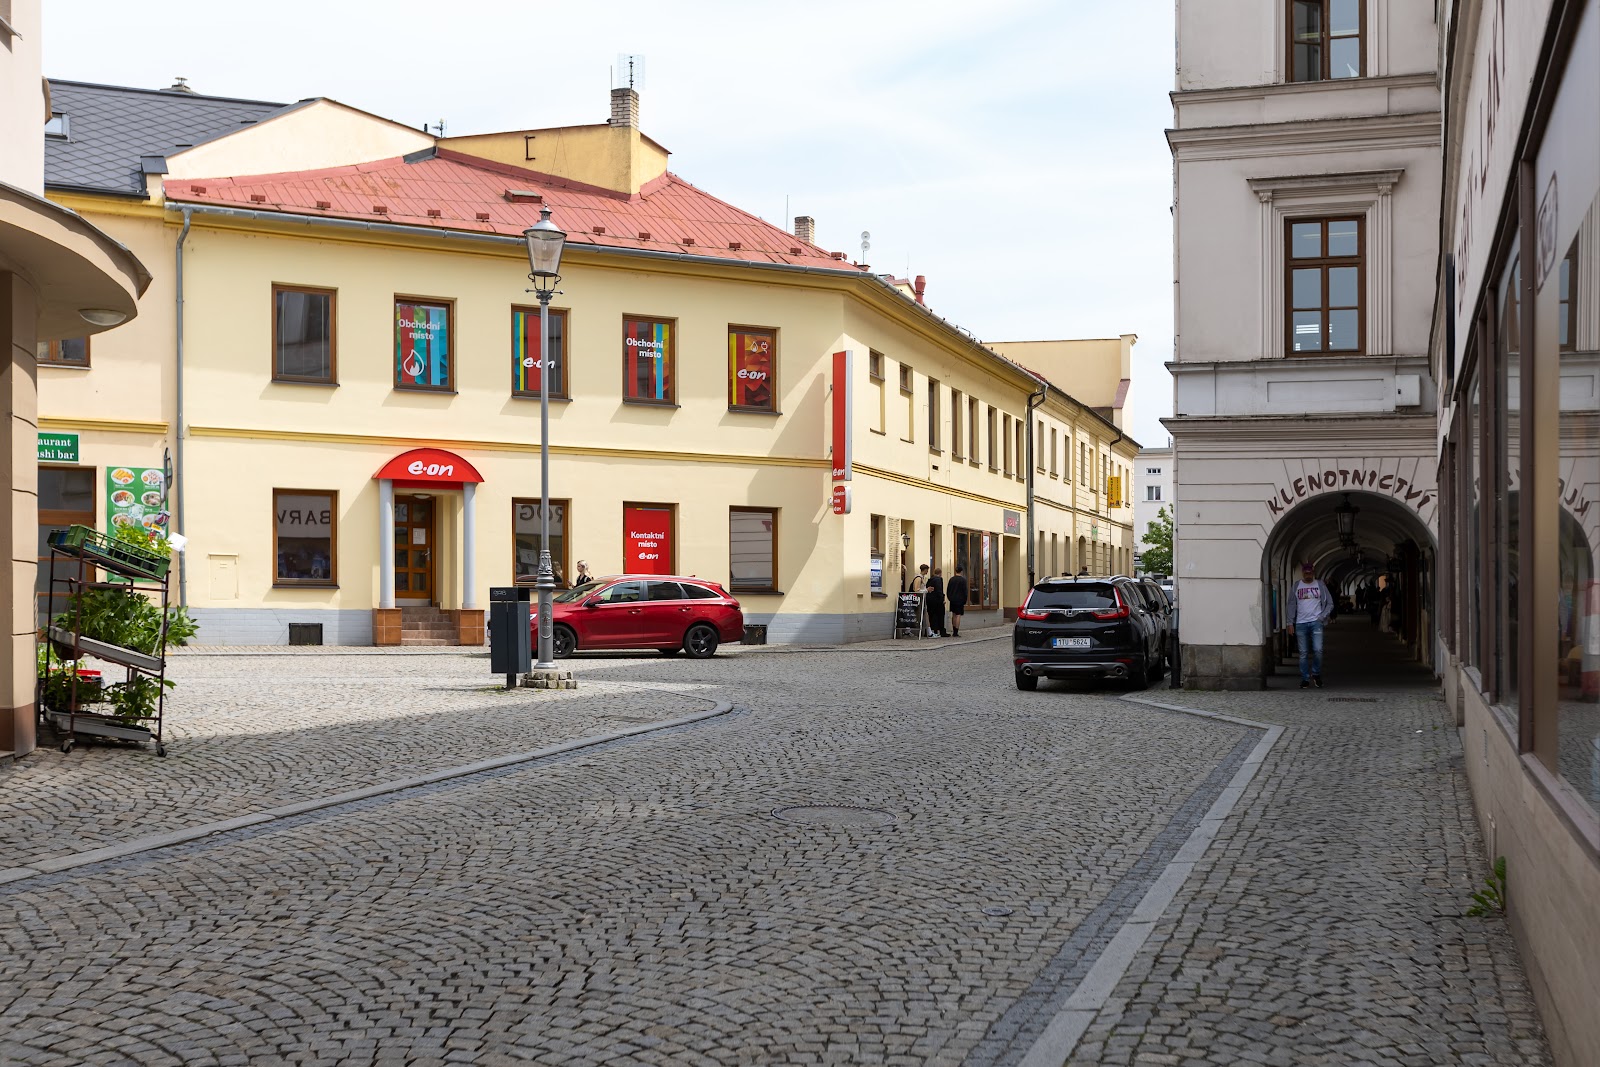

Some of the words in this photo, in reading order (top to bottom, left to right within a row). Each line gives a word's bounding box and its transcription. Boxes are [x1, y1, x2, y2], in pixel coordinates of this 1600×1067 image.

[398, 318, 441, 331] Obchodní
[409, 330, 435, 341] místo
[626, 337, 664, 349] Obchodní
[639, 348, 662, 359] místo
[57, 449, 75, 460] bar
[1267, 469, 1437, 515] KLENOTNICTVÍ
[630, 531, 665, 540] Kontaktní
[638, 540, 658, 548] místo
[1058, 638, 1068, 646] 1TU
